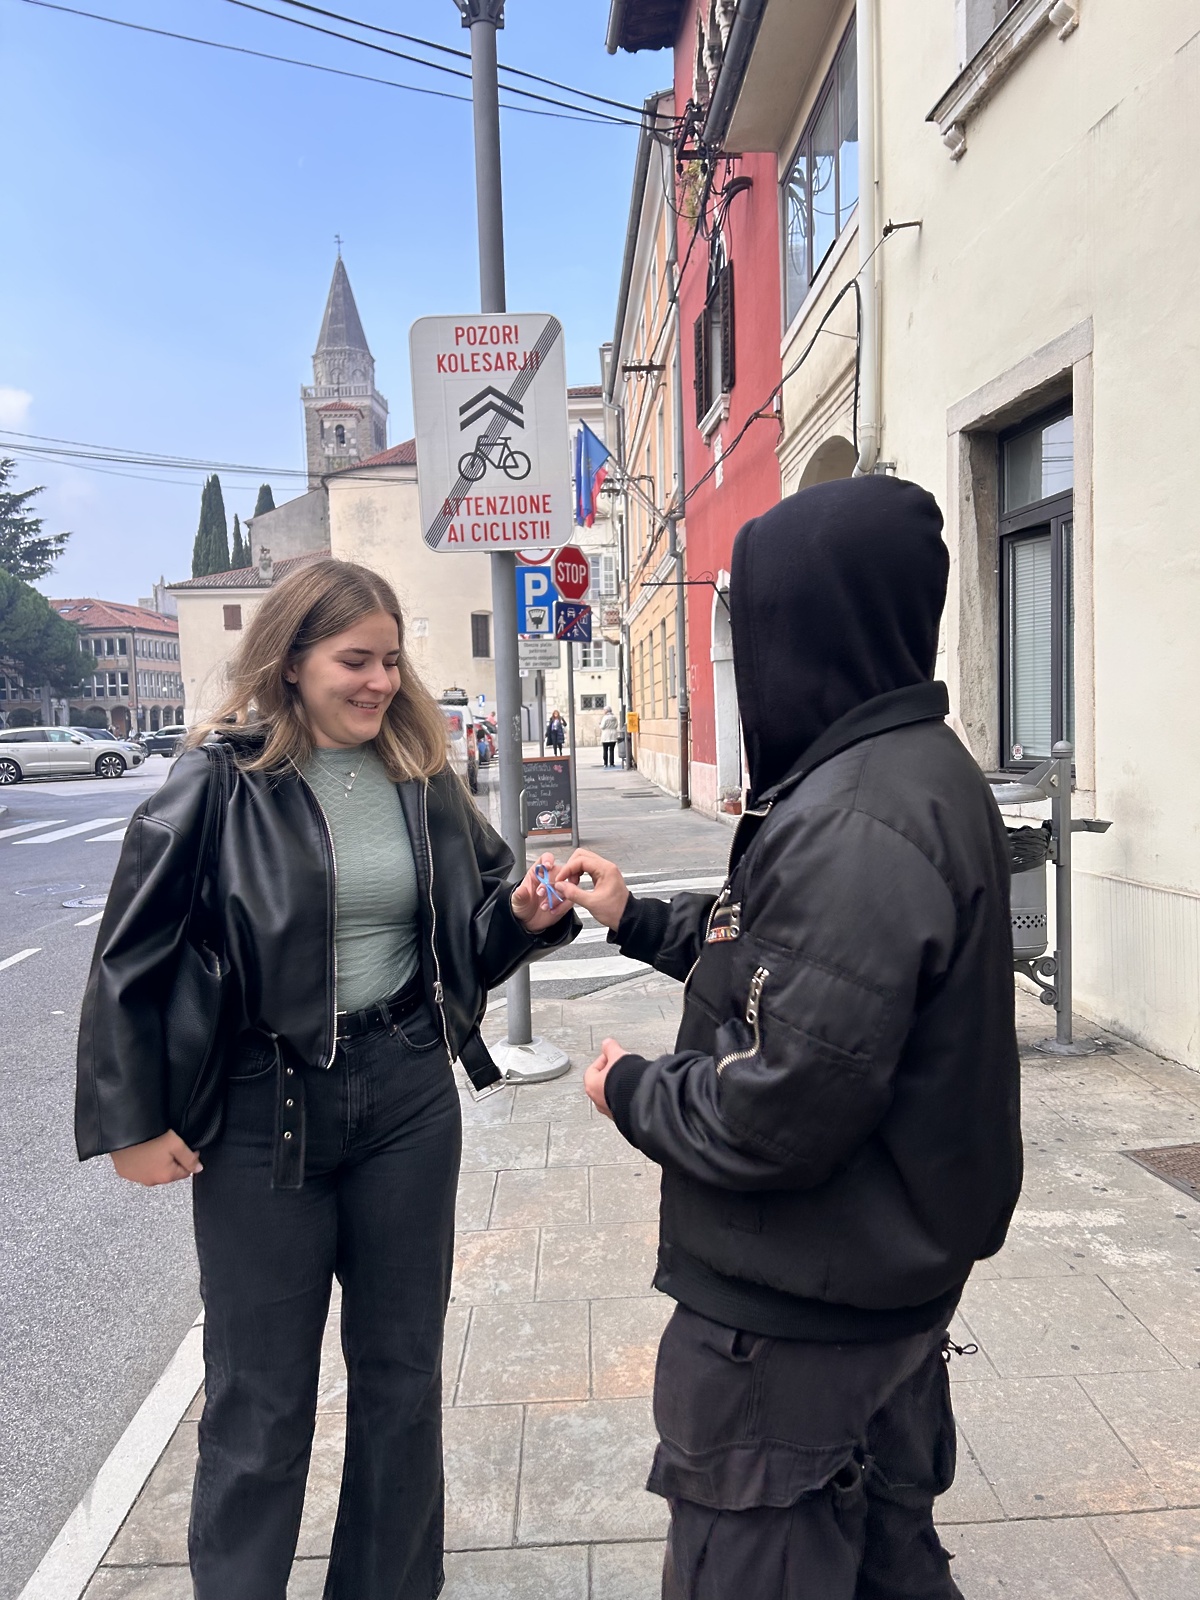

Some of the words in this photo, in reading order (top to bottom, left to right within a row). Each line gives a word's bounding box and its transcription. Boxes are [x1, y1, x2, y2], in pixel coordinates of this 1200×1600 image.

[454, 325, 519, 346] POZOR!
[442, 494, 552, 517] ATTENZIONE
[447, 523, 465, 543] AI
[471, 520, 550, 542] CICLISTI!
[557, 561, 587, 585] STOP
[524, 572, 548, 606] P
